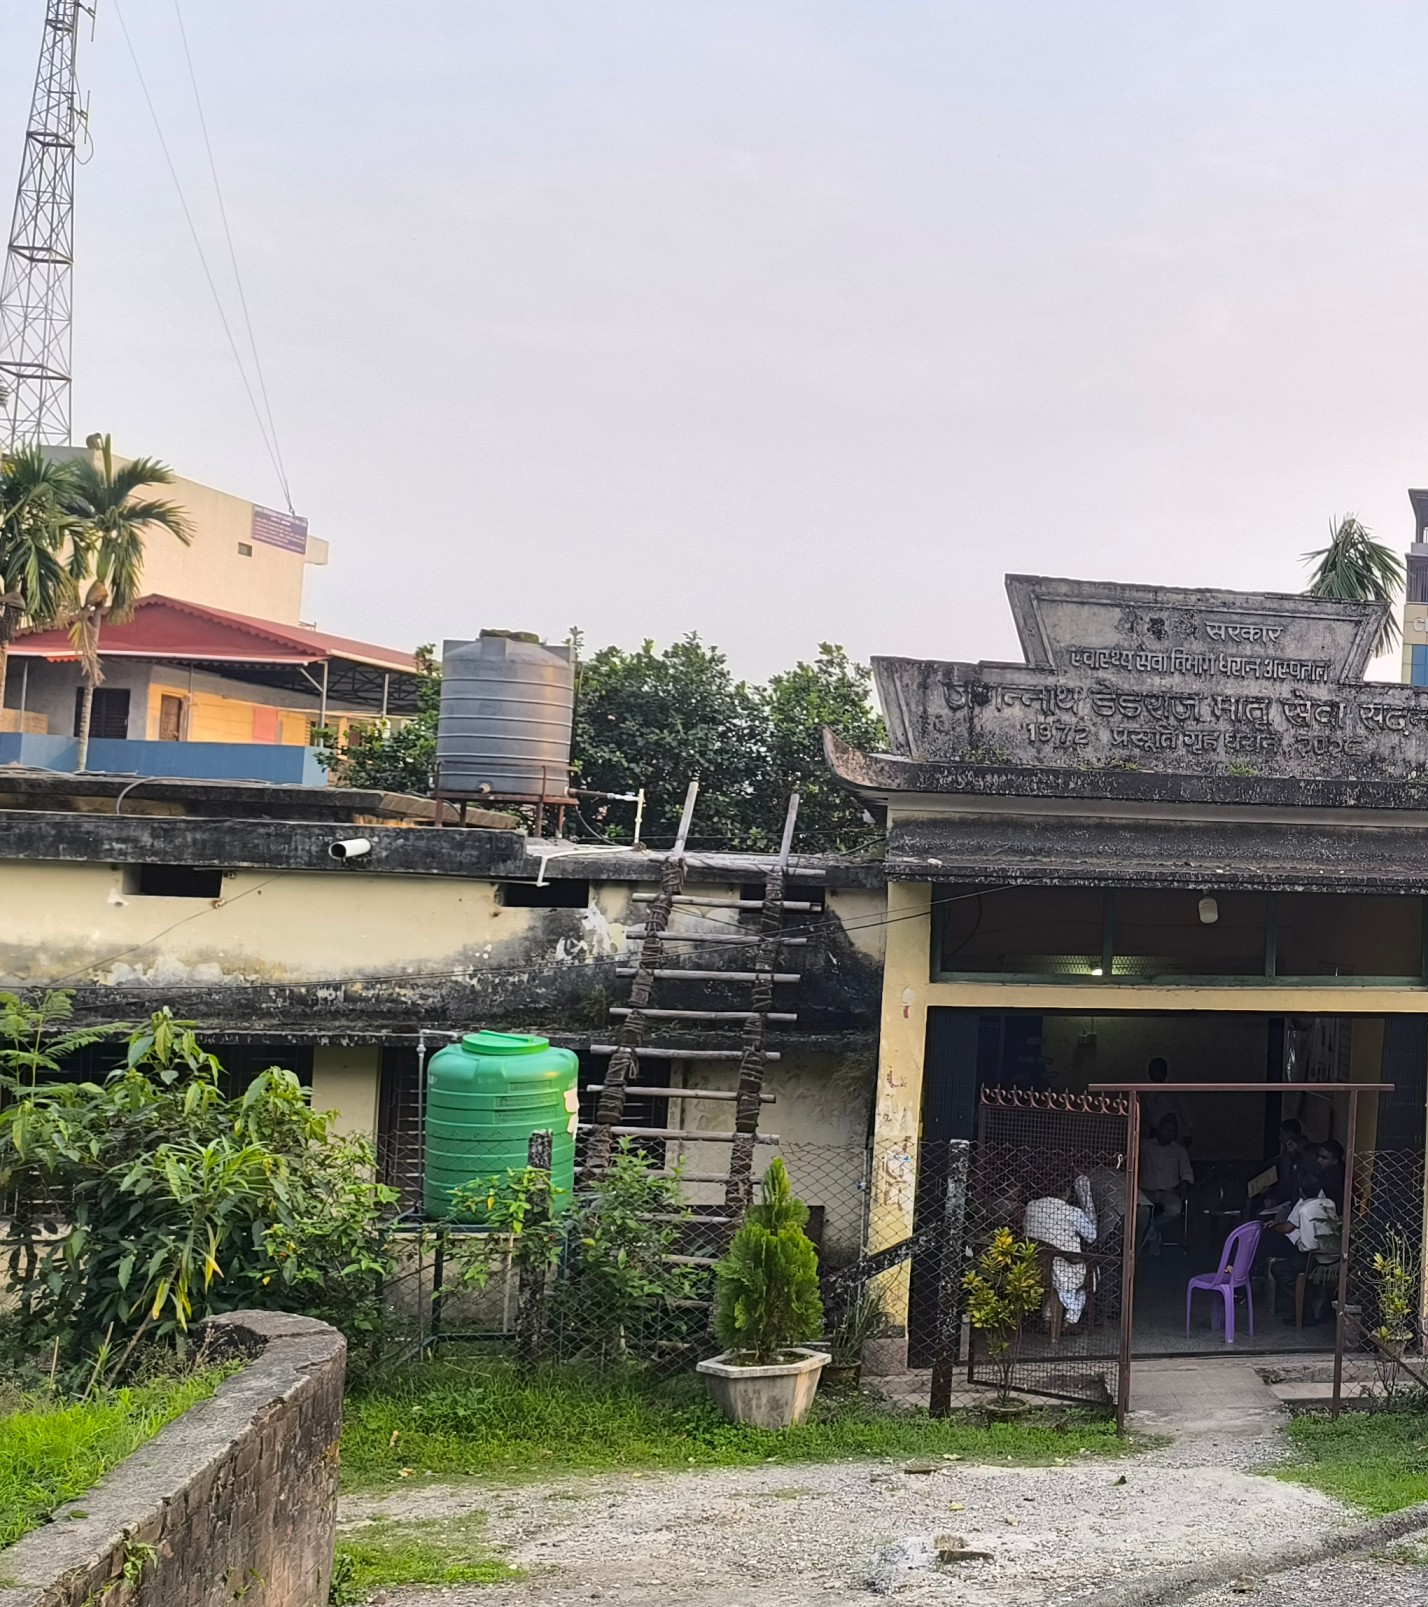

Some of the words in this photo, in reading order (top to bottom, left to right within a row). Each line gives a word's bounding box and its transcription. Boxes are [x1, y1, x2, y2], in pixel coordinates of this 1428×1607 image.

[1204, 620, 1285, 644] सरकार
[1170, 647, 1216, 675] विभाग
[1218, 653, 1261, 678] धरान
[1263, 659, 1331, 681] अस्पताल
[1026, 722, 1091, 745] 1972
[1182, 731, 1219, 755] गृह
